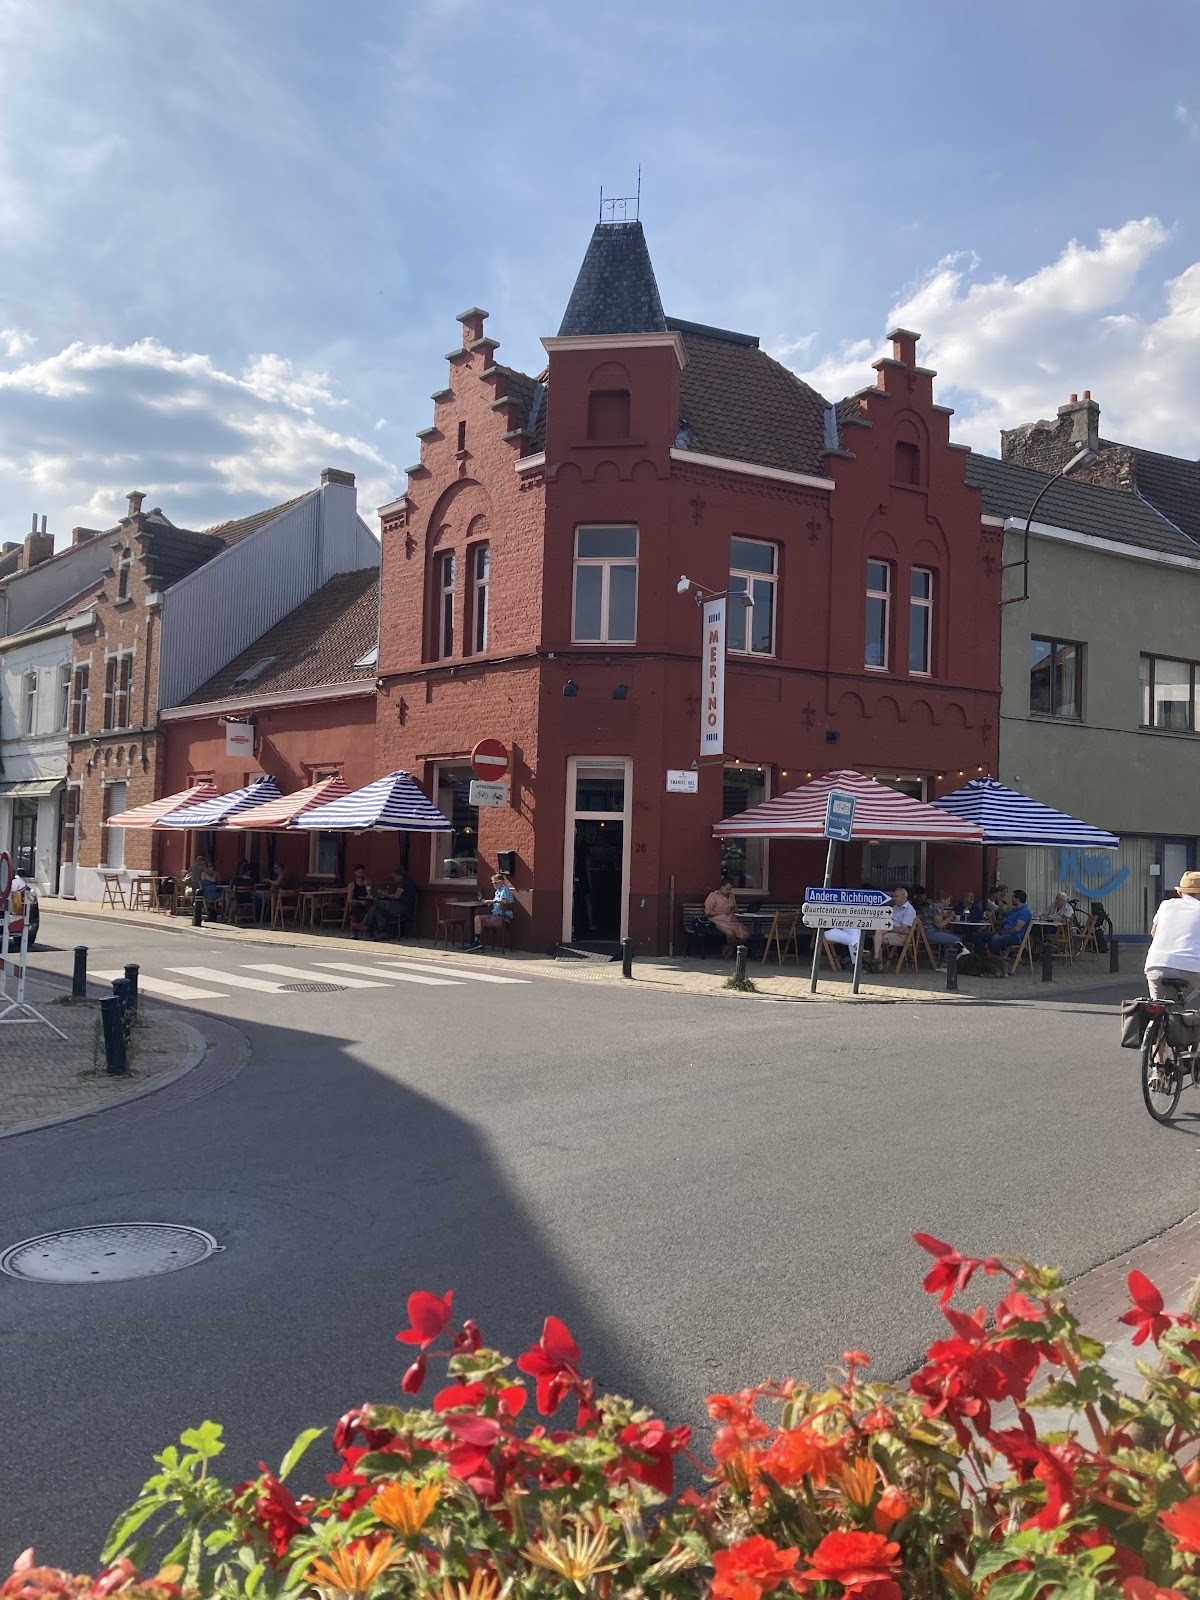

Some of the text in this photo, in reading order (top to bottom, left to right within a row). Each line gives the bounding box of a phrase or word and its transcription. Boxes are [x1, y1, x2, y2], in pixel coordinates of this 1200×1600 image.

[708, 630, 719, 727] MERINO
[635, 843, 647, 852] 26
[810, 890, 883, 905] Andere Richtingen
[804, 905, 884, 917] Buurtcentrum Gentbrugge
[818, 918, 873, 928] De Vierde Zaal
